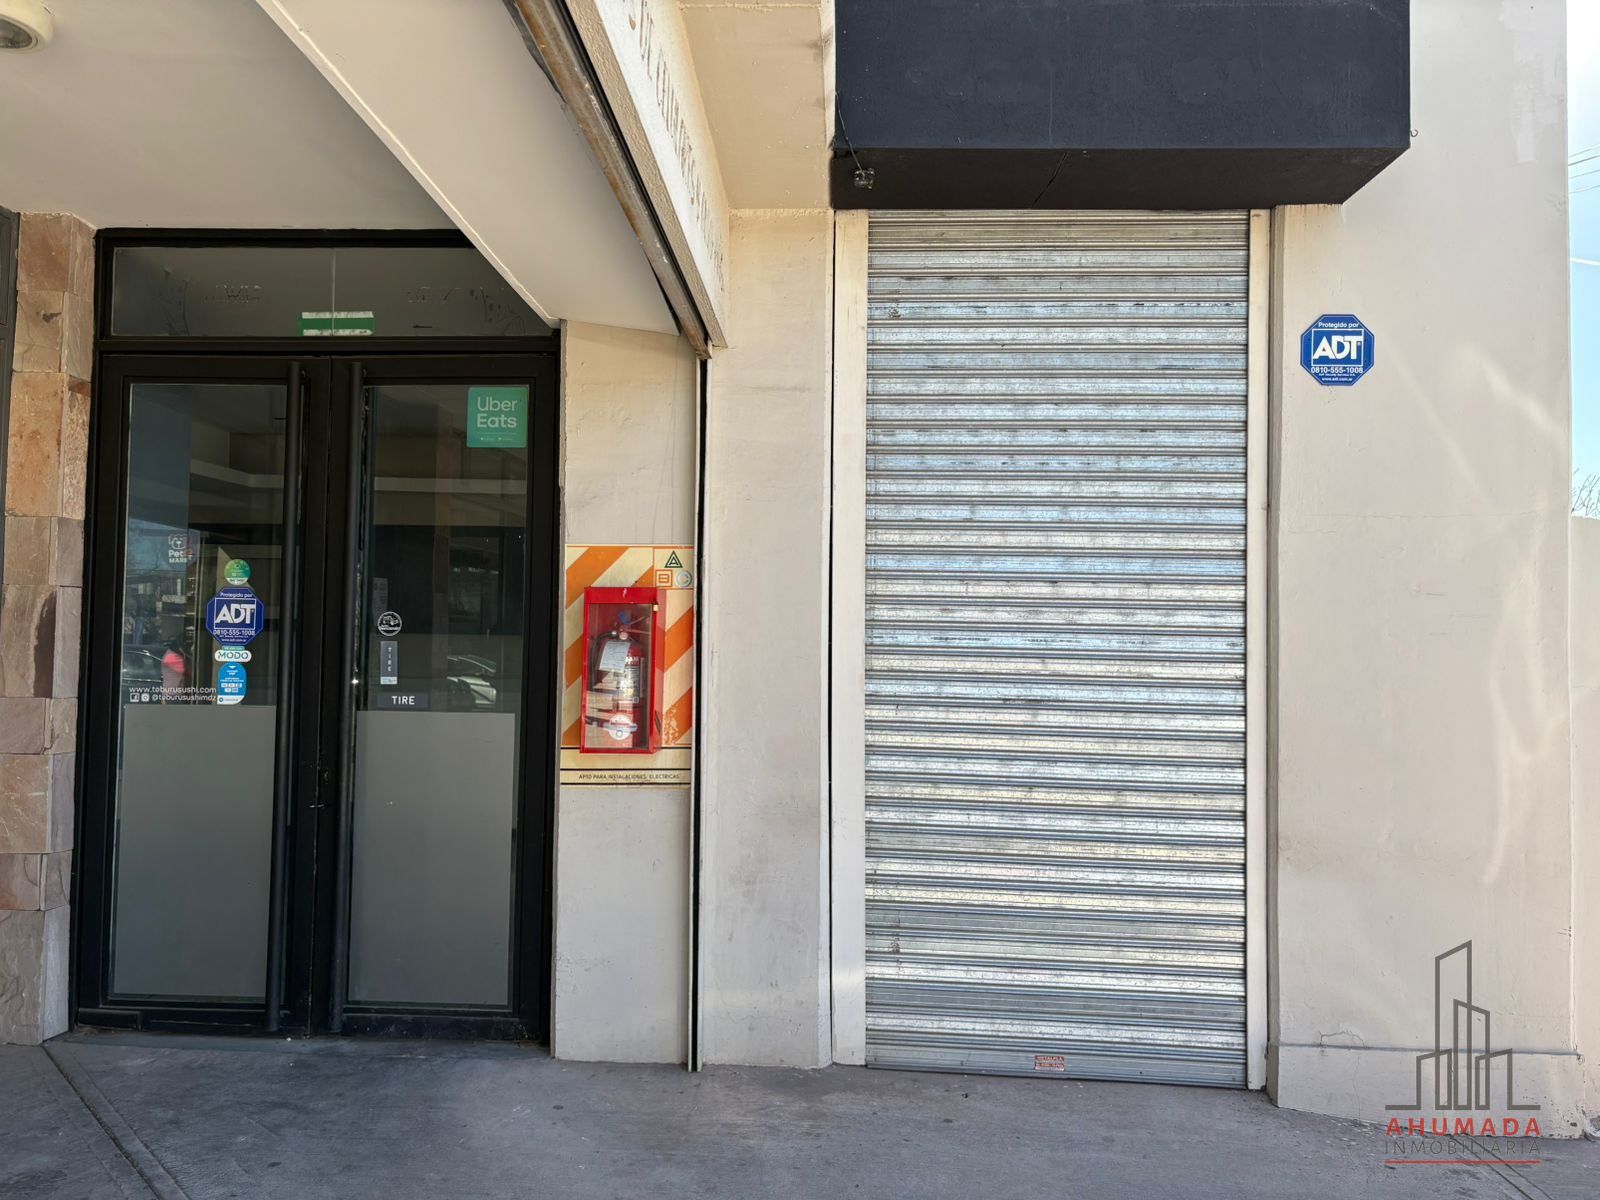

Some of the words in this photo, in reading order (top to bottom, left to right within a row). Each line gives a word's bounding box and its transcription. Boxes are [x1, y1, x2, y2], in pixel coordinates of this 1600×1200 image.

[1312, 335, 1364, 360] ADT
[477, 396, 518, 412] Uber
[477, 413, 517, 428] Eats
[215, 604, 256, 624] ADT
[217, 651, 249, 660] MODO
[391, 695, 416, 706] TIRE
